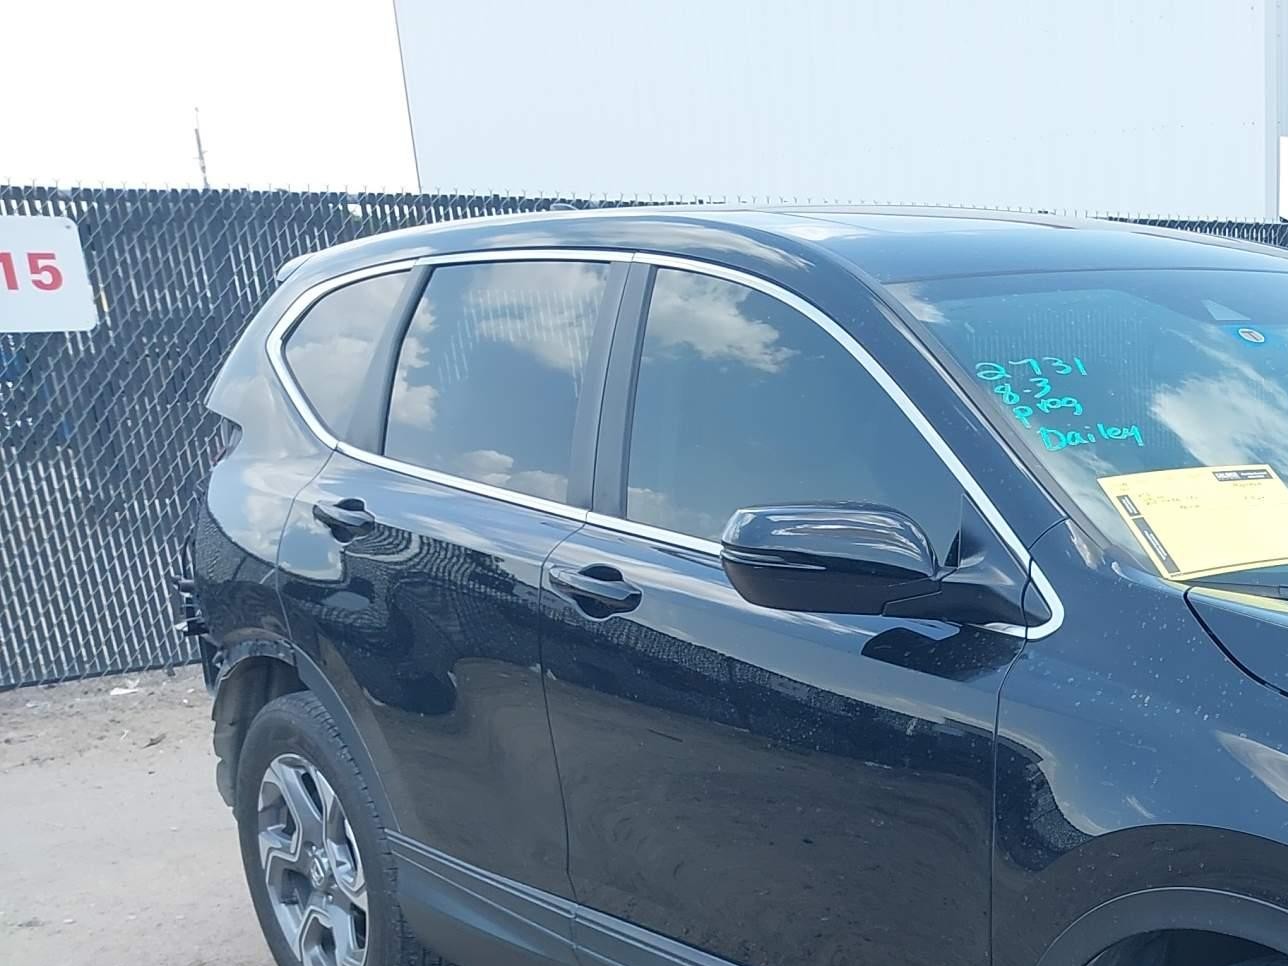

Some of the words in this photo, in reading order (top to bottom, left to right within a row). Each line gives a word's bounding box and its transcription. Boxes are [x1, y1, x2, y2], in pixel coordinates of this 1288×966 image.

[975, 356, 1088, 381] 2731
[993, 377, 1052, 405] 8-3
[1036, 423, 1145, 452] Dailey
